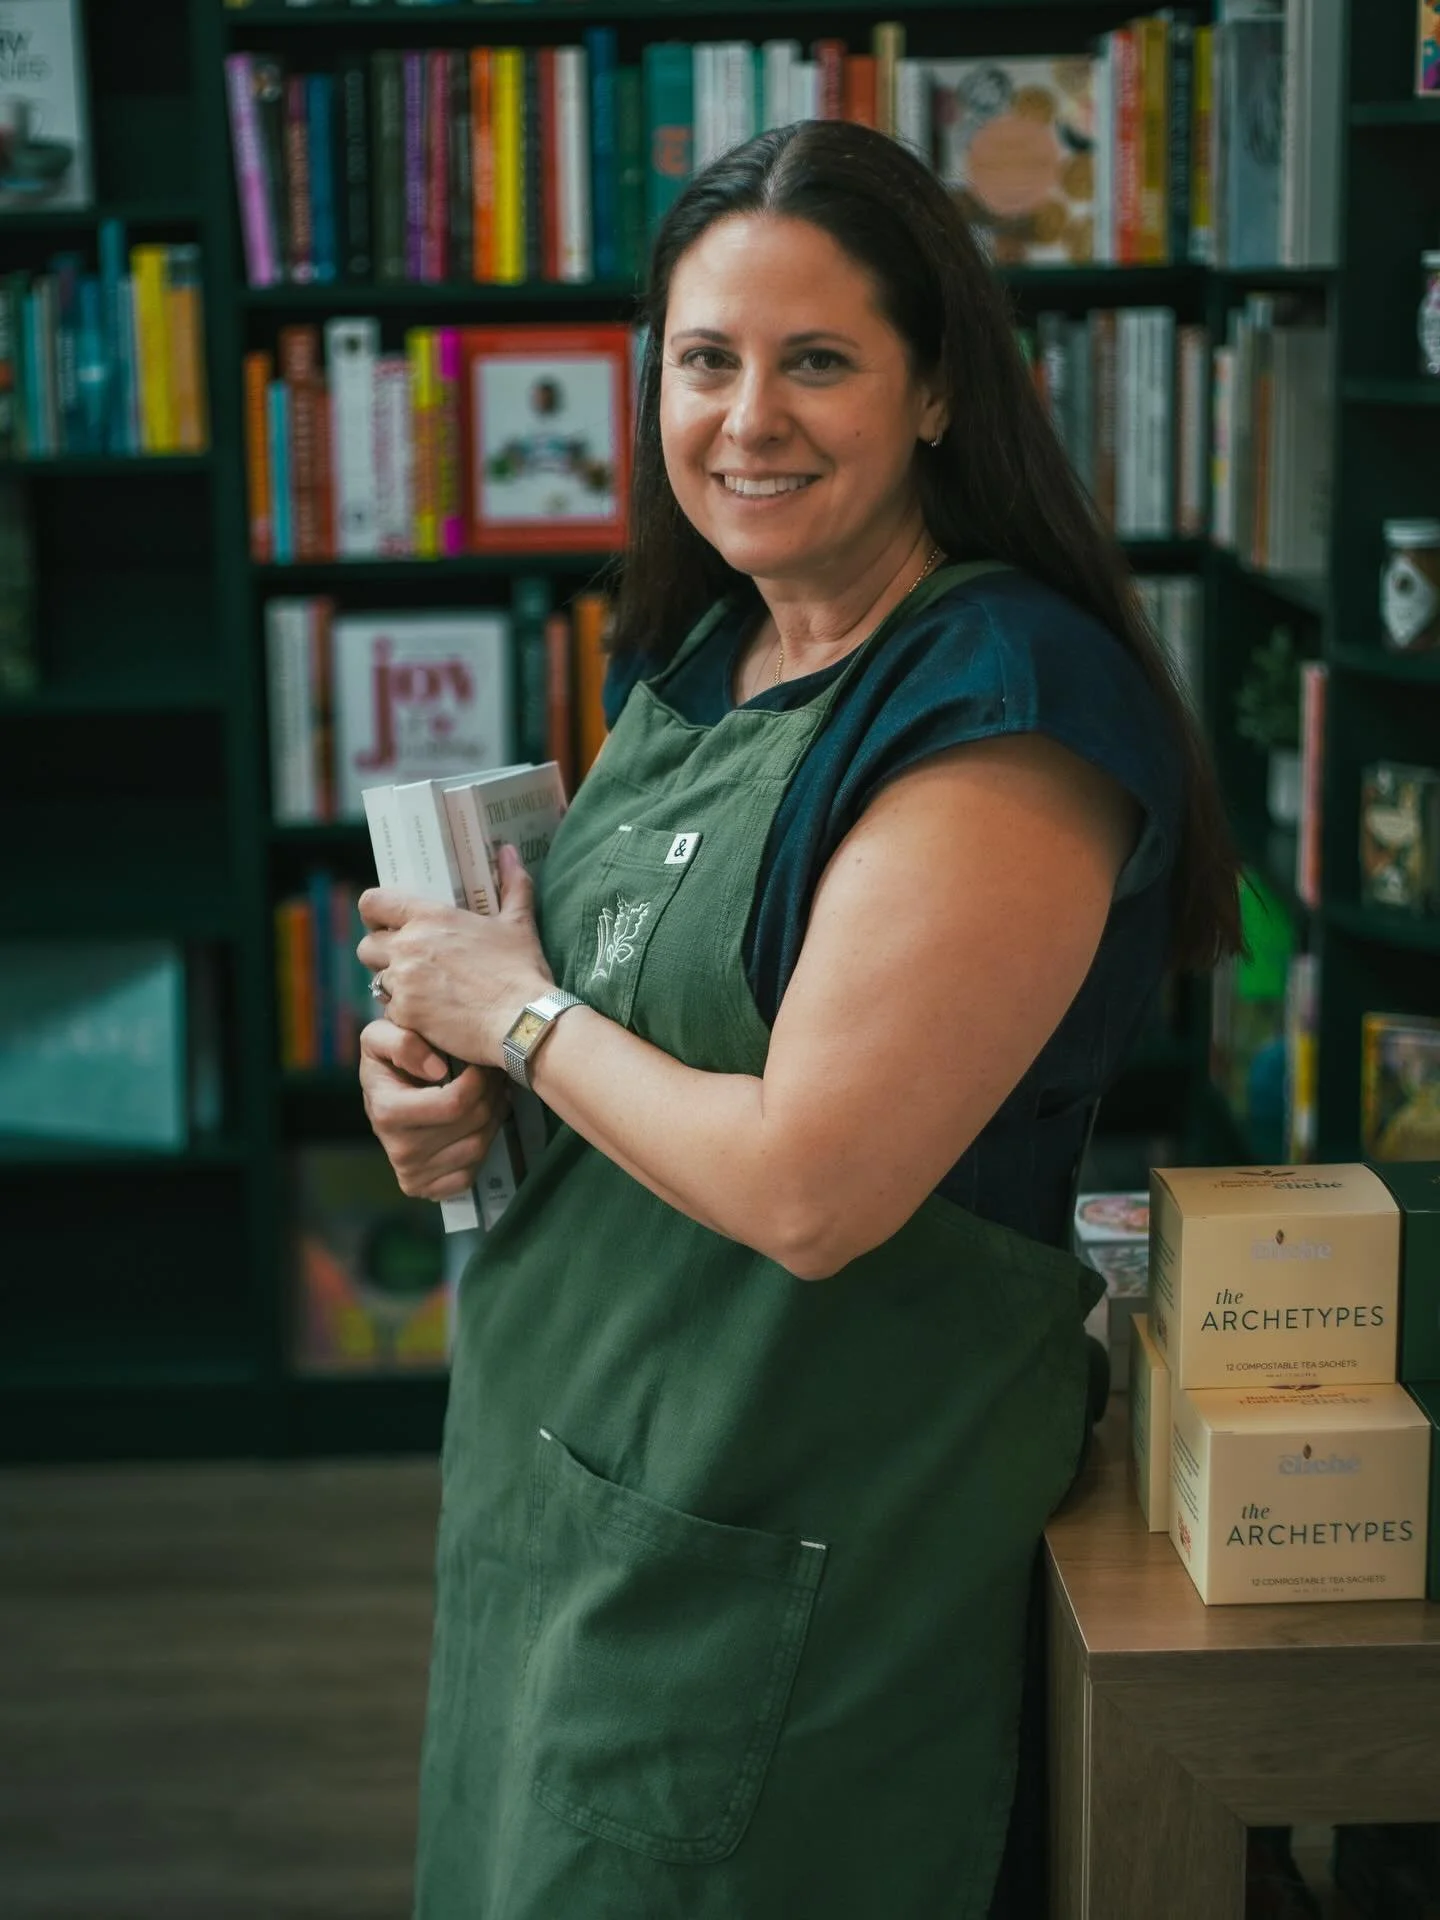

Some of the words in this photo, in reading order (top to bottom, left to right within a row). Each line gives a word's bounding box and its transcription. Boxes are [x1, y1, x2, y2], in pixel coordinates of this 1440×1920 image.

[674, 838, 687, 857] &
[1215, 1288, 1244, 1305] the
[1200, 1305, 1385, 1332] ARCHETYPES
[1226, 1363, 1235, 1371] 12
[1236, 1361, 1299, 1370] COMPOSTABLE
[1300, 1360, 1317, 1369] TEA
[1318, 1359, 1358, 1369] SACHETS
[1241, 1503, 1271, 1520] the
[1226, 1520, 1414, 1547] ARCHETYPES
[1251, 1578, 1260, 1587] 12
[1261, 1576, 1326, 1586] COMPOSTABLE
[1328, 1575, 1346, 1585] TEA
[1346, 1574, 1386, 1584] SACHETS
